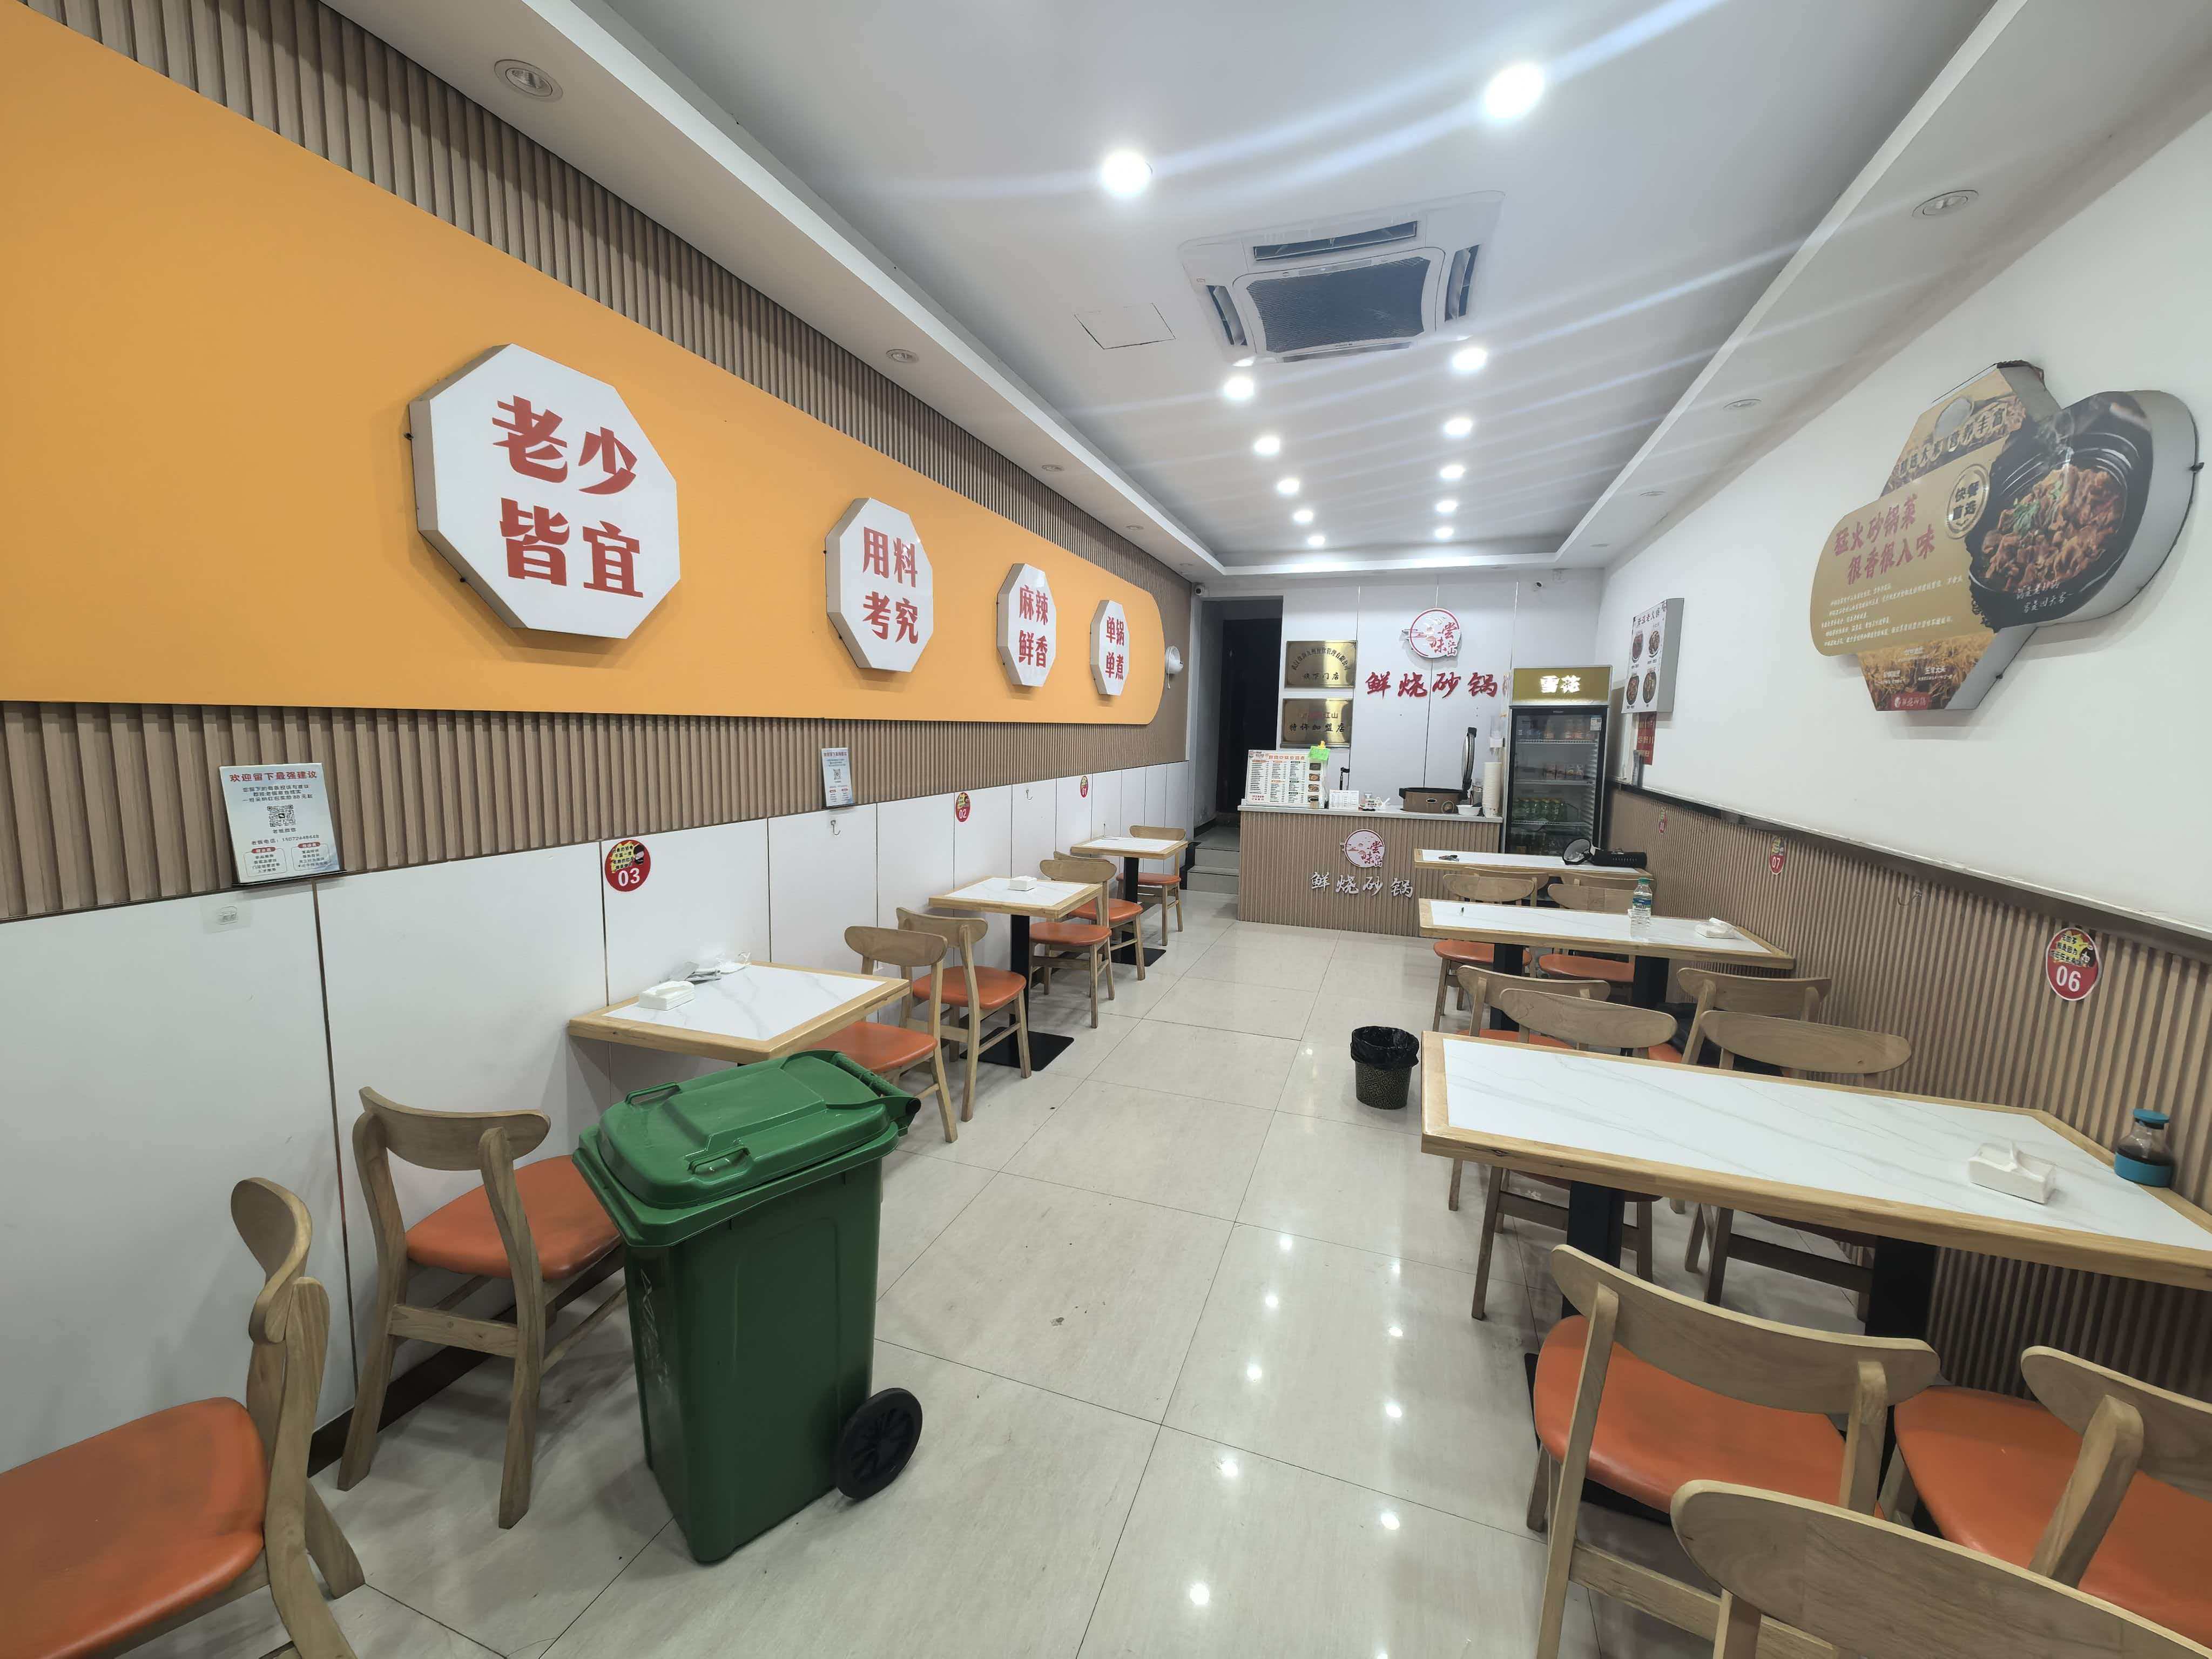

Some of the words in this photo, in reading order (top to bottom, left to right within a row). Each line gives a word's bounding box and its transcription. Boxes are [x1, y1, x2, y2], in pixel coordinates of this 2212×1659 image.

[492, 395, 638, 495] 老少
[500, 497, 644, 598] 皆宜
[862, 527, 918, 588] 用料
[1847, 523, 1935, 585] 很香很入味
[862, 591, 918, 644] 考究
[1019, 585, 1048, 625] 麻辣
[1105, 616, 1124, 645] 单锅
[1019, 630, 1048, 668] 鲜香
[1105, 652, 1124, 681] 单煮
[1365, 672, 1498, 699] 鲜烧砂锅
[1540, 675, 1581, 693] 雪花
[1289, 723, 1345, 733] 特许加盟店
[1082, 787, 1087, 796] 01
[959, 809, 967, 819] 02
[1772, 857, 1781, 869] 07
[618, 868, 640, 887] 03
[1311, 871, 1413, 899] 鲜烧砂锅
[2056, 965, 2081, 992] 06
